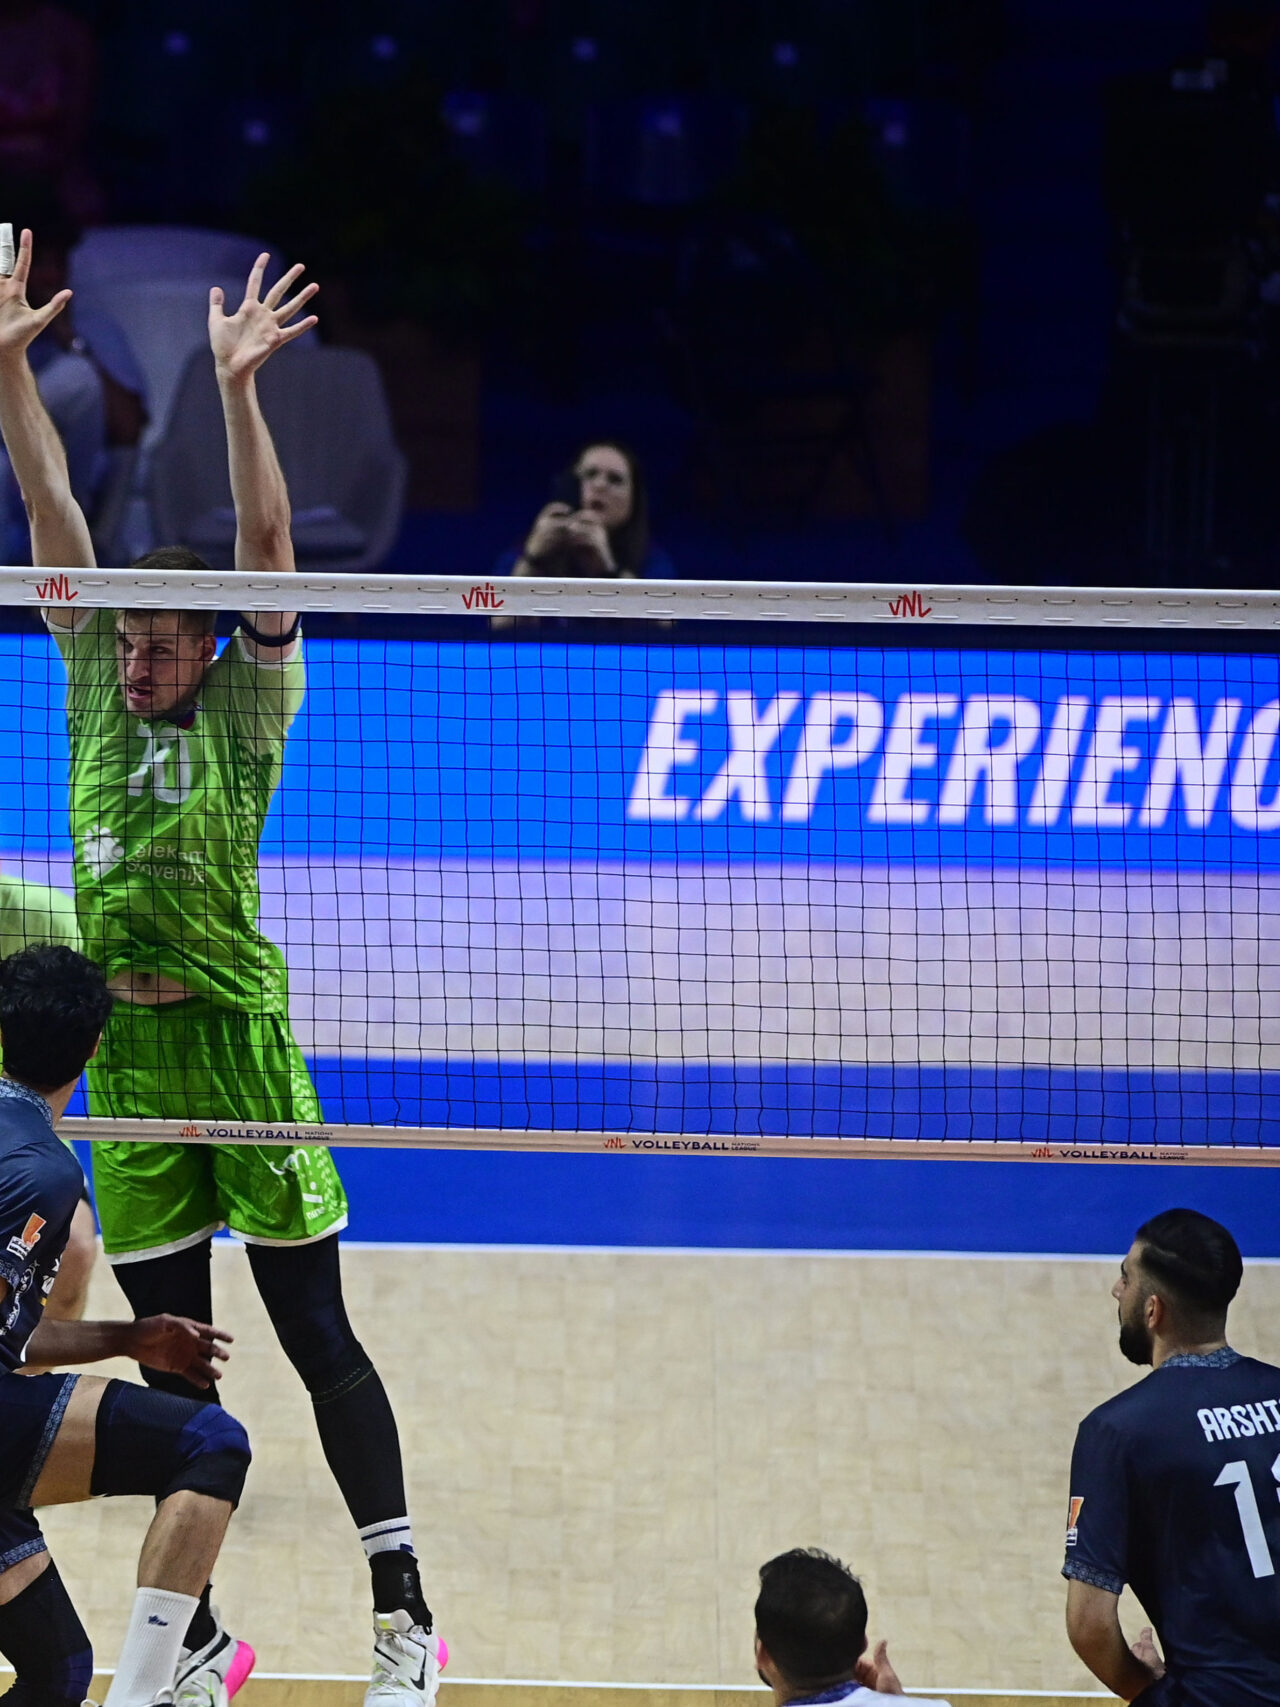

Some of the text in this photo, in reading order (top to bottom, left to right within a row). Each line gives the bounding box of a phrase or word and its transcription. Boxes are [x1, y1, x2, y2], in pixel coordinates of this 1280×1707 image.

[36, 574, 78, 601] VNL
[462, 582, 504, 610] VNL
[889, 591, 932, 618] VNL
[206, 1128, 303, 1140] VOLLEYBALL
[632, 1140, 729, 1151] VOLLEYBALL
[1060, 1150, 1157, 1160] VOLLEYBALL
[1197, 1399, 1280, 1442] ARSHI
[1213, 1453, 1280, 1578] 1
